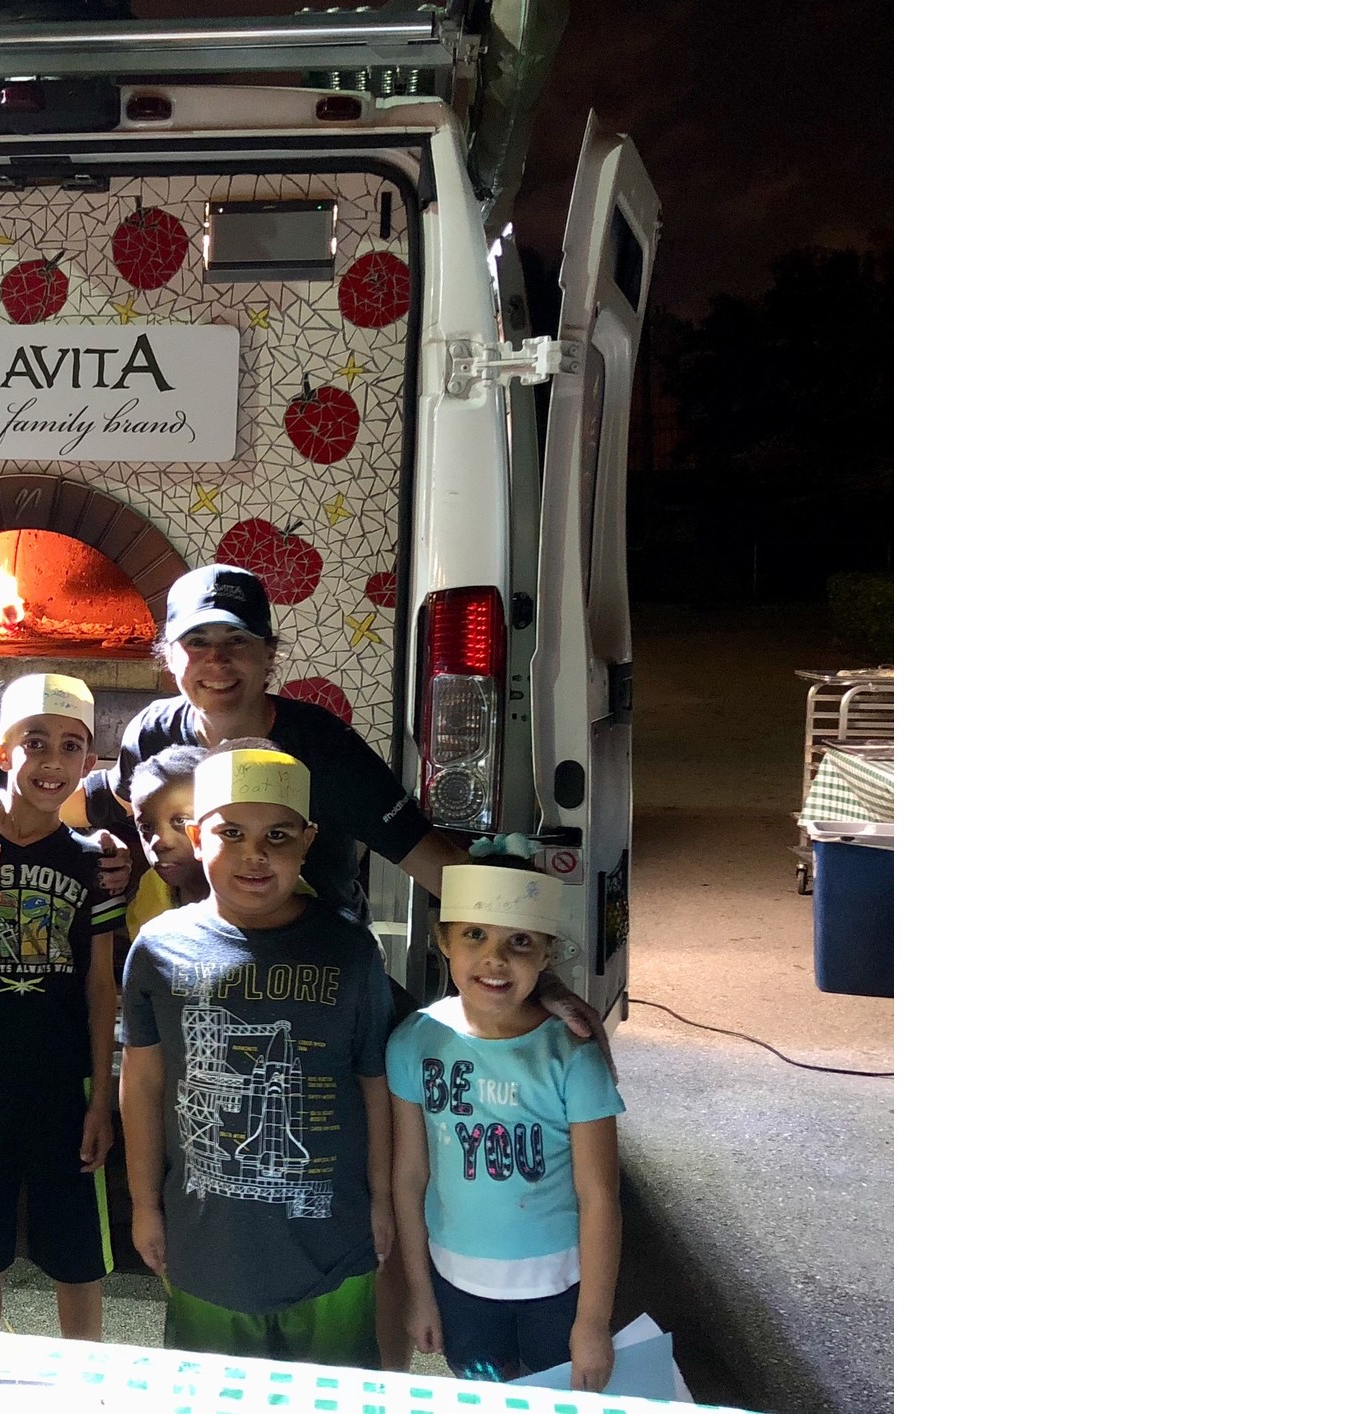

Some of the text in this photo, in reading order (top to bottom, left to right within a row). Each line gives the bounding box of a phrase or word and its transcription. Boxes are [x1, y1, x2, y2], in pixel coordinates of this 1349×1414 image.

[102, 397, 196, 444] brand
[19, 864, 89, 908] MOVE!
[16, 963, 52, 974] ALWAYS
[171, 961, 340, 1006] EXPLORE
[422, 1058, 518, 1117] BE TRUE
[454, 1122, 546, 1183] YOU
